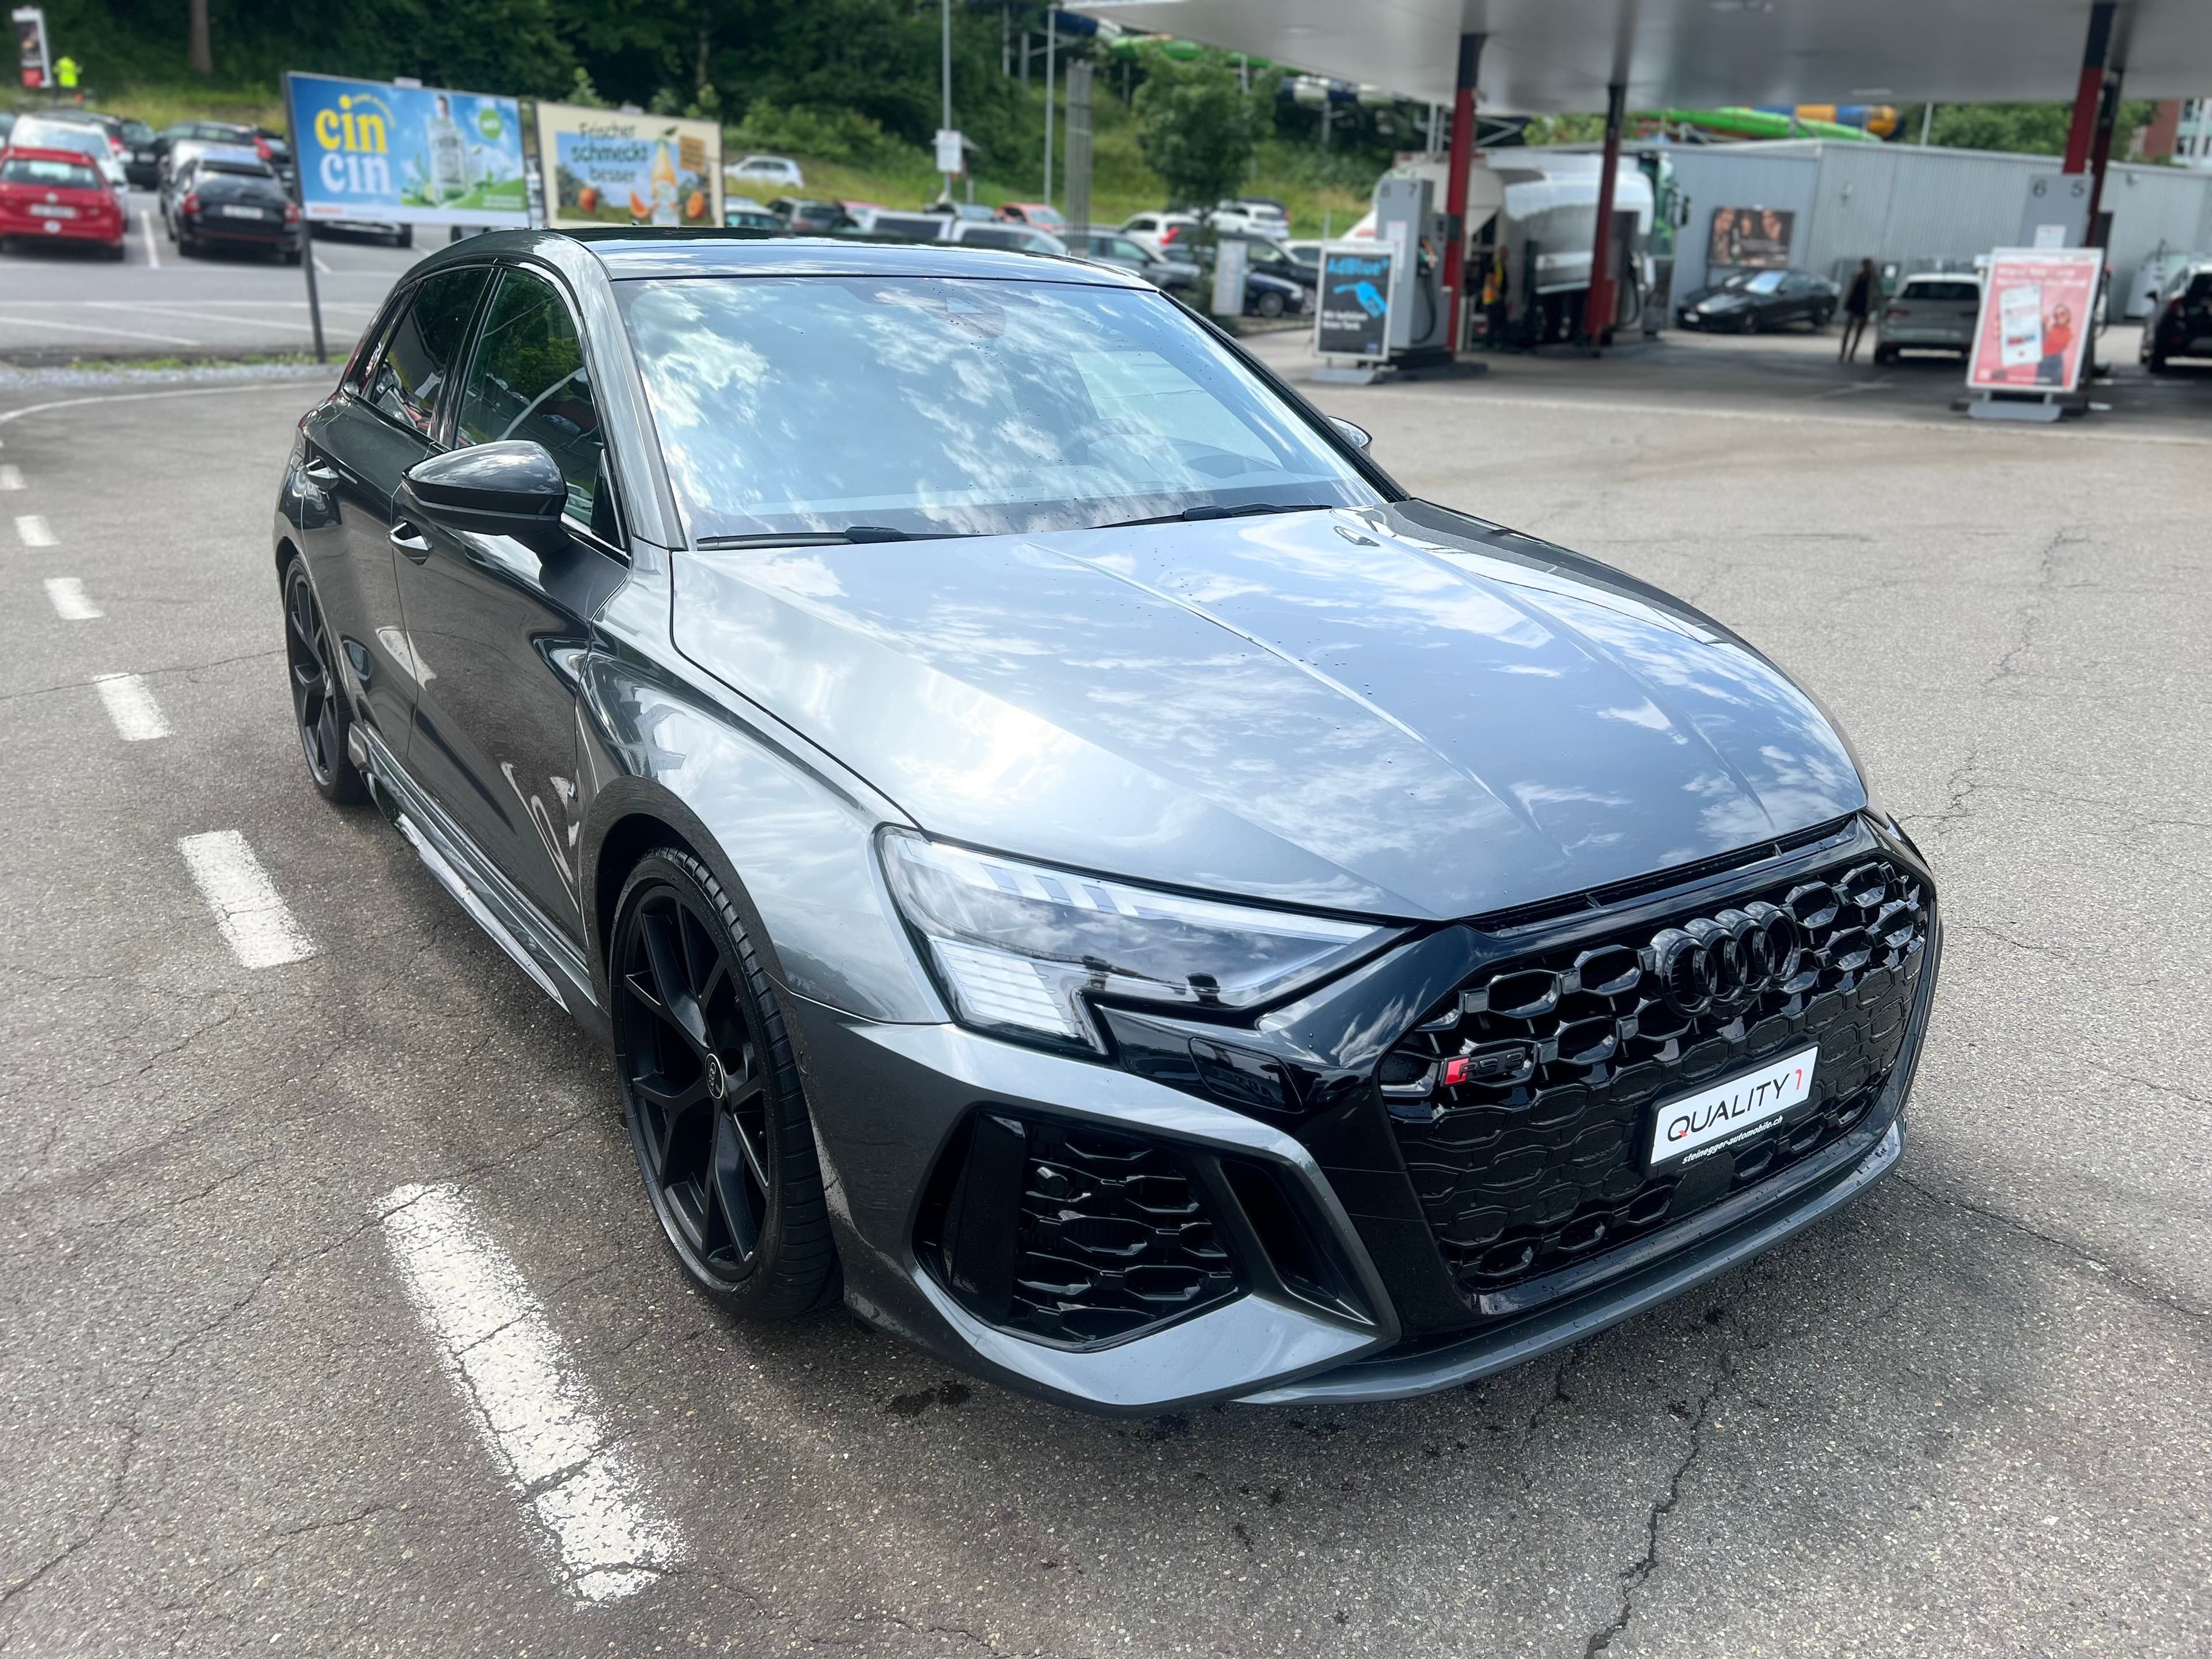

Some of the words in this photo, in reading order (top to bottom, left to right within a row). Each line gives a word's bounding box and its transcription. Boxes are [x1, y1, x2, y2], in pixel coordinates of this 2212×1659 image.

[314, 94, 388, 154] cin
[320, 153, 393, 195] cin
[571, 143, 647, 162] schmeckt
[2032, 178, 2047, 198] 6
[2070, 179, 2085, 198] 5
[1667, 1073, 1790, 1142] QUALITY
[1681, 1115, 1783, 1164] steinegger-automobile.ch
